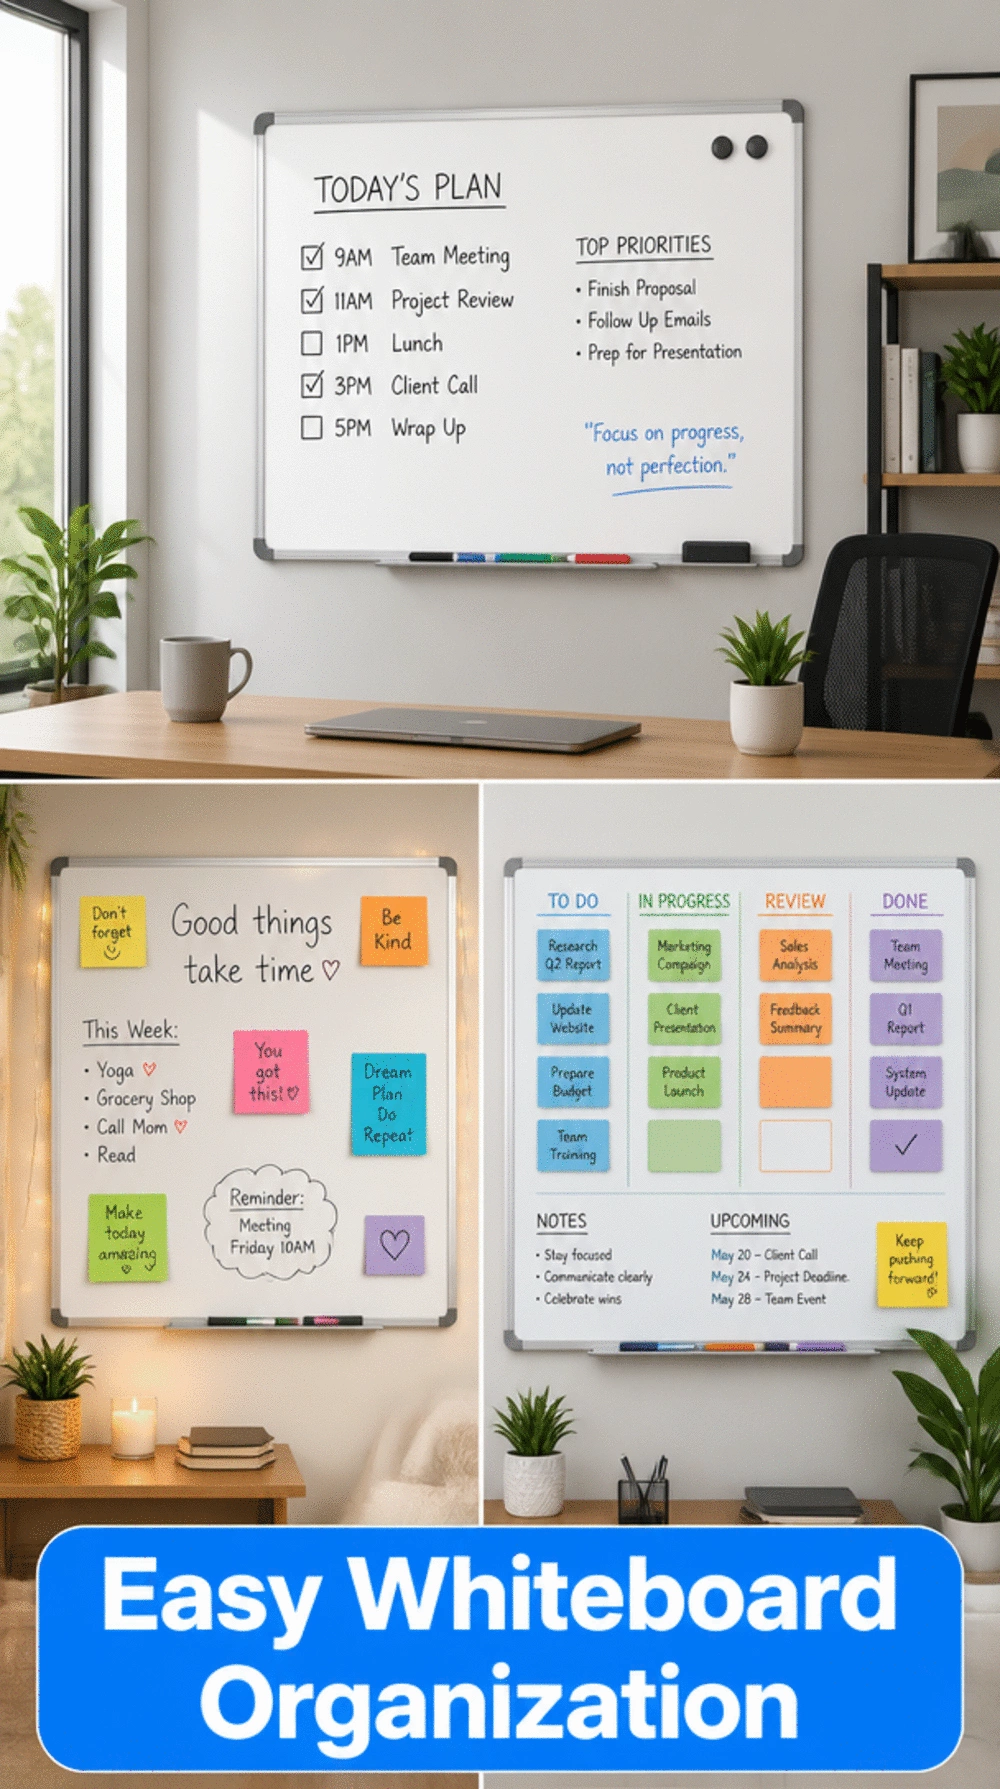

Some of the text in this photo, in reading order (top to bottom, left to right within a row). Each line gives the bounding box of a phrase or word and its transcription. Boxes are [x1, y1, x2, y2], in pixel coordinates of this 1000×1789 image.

[314, 173, 500, 203] TODAY'S PLAN
[576, 235, 711, 255] TOP PRIORITIES
[335, 245, 510, 272] 9AM Team Meeting
[589, 279, 695, 300] Finish Proposal
[335, 289, 514, 317] 11AM Project Review
[589, 310, 711, 332] Follow Up Emails
[337, 333, 443, 352] 1PM Lunch
[589, 343, 742, 366] Prep for Presentation
[335, 374, 477, 395] 3PM Client Call
[336, 418, 466, 444] 5PM Wrap Up
[645, 426, 665, 442] on
[672, 426, 744, 448] progress,
[607, 458, 633, 475] not
[548, 893, 598, 908] TO DO
[639, 894, 730, 908] IN PROGRESS
[766, 893, 825, 908] REVIEW
[883, 893, 927, 909] DONE
[93, 906, 126, 920] Don't
[383, 908, 401, 925] Be
[172, 902, 332, 948] Good things
[92, 925, 131, 944] forget
[375, 932, 411, 949] Kind
[549, 939, 597, 952] Research
[658, 940, 711, 959] Marketing
[780, 939, 808, 952] Sales
[891, 940, 920, 952] Team
[184, 954, 313, 984] take time
[545, 957, 602, 973] Q2 Report
[657, 956, 712, 975] Campaign
[773, 958, 818, 974] Analysis
[885, 958, 928, 975] Meeting
[551, 1003, 592, 1019] Update
[667, 1003, 698, 1015] Client
[771, 1003, 819, 1015] Feedback
[898, 1003, 912, 1016] Q1
[83, 1019, 179, 1039] This Week:
[551, 1023, 594, 1033] Website
[654, 1021, 717, 1034] Presentation
[771, 1021, 822, 1038] Summary
[888, 1021, 925, 1038] Report
[255, 1042, 282, 1058] You
[97, 1062, 134, 1083] Yoga
[256, 1064, 280, 1084] got
[365, 1063, 412, 1079] Dream
[552, 1066, 594, 1081] Prepare
[662, 1066, 705, 1079] Product
[886, 1067, 926, 1082] System
[249, 1083, 283, 1101] this!
[373, 1086, 402, 1100] Plan
[553, 1085, 592, 1101] Budget
[664, 1085, 704, 1097] Launch
[886, 1085, 926, 1100] Update
[97, 1088, 196, 1113] Grocery Shop
[378, 1107, 396, 1121] Do
[97, 1118, 167, 1134] Call Mom
[364, 1126, 415, 1147] Repeat
[558, 1130, 587, 1142] Team
[98, 1145, 135, 1162] Read
[550, 1148, 596, 1165] Training
[231, 1188, 303, 1206] Reminder:
[105, 1205, 143, 1220] Make
[537, 1213, 586, 1228] NOTES
[711, 1213, 789, 1228] UPCOMING
[105, 1226, 145, 1244] today
[240, 1218, 291, 1238] Meeting
[231, 1239, 315, 1260] Friday 10AM
[896, 1235, 924, 1248] Keep
[545, 1248, 612, 1265] Stay focused
[712, 1249, 734, 1264] May
[738, 1249, 751, 1260] 20
[765, 1249, 794, 1260] Client
[799, 1249, 817, 1260] Call
[545, 1270, 652, 1286] Communicate clearly
[712, 1271, 734, 1286] May
[738, 1271, 750, 1282] 24
[764, 1270, 799, 1286] Project
[545, 1292, 621, 1304] Celebrate wins
[712, 1294, 733, 1308] May
[739, 1293, 751, 1304] 28
[766, 1293, 793, 1304] Team
[797, 1293, 826, 1304] Event
